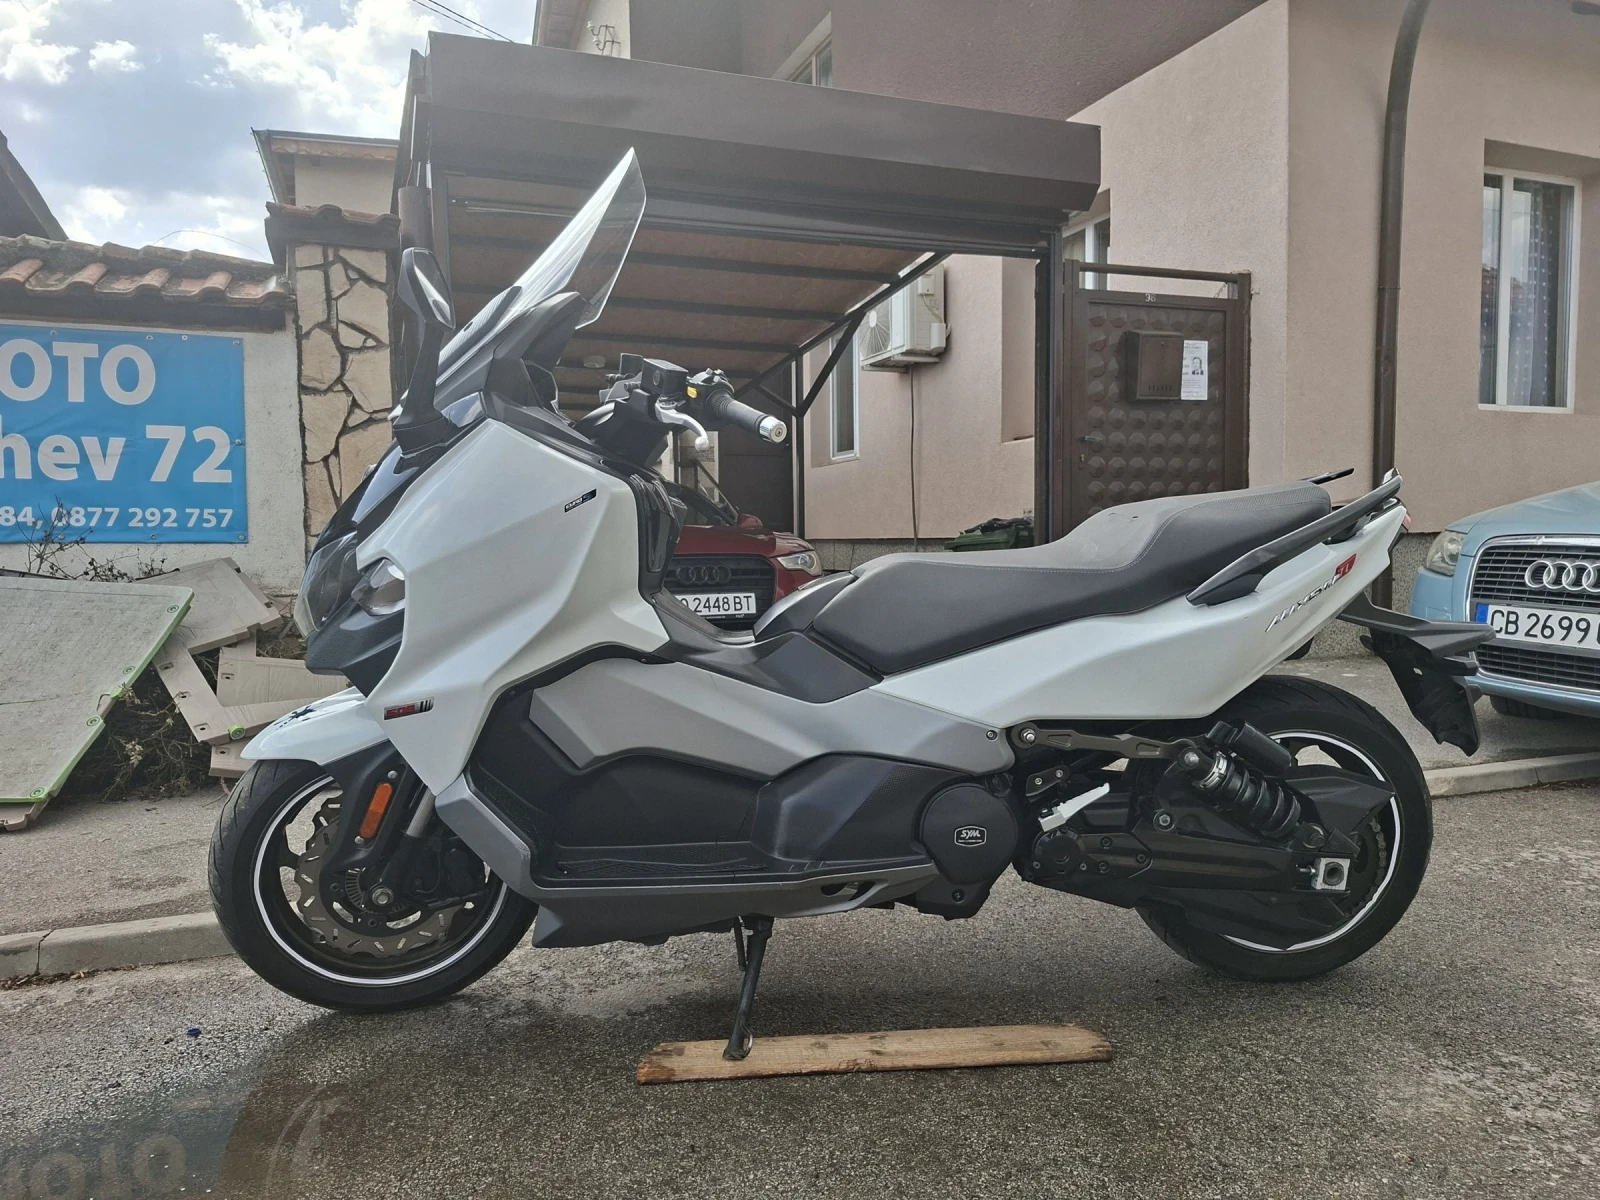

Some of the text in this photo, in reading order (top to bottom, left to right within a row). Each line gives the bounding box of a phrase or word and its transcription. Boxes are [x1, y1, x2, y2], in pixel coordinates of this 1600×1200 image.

[0, 338, 156, 405] OTO
[145, 424, 233, 483] 72
[0, 506, 233, 529] 84, 0877 292 757
[694, 597, 731, 612] 2448
[734, 595, 752, 611] BT
[1490, 609, 1520, 635] CB
[1524, 612, 1591, 643] 2699
[960, 829, 981, 839] SYM
